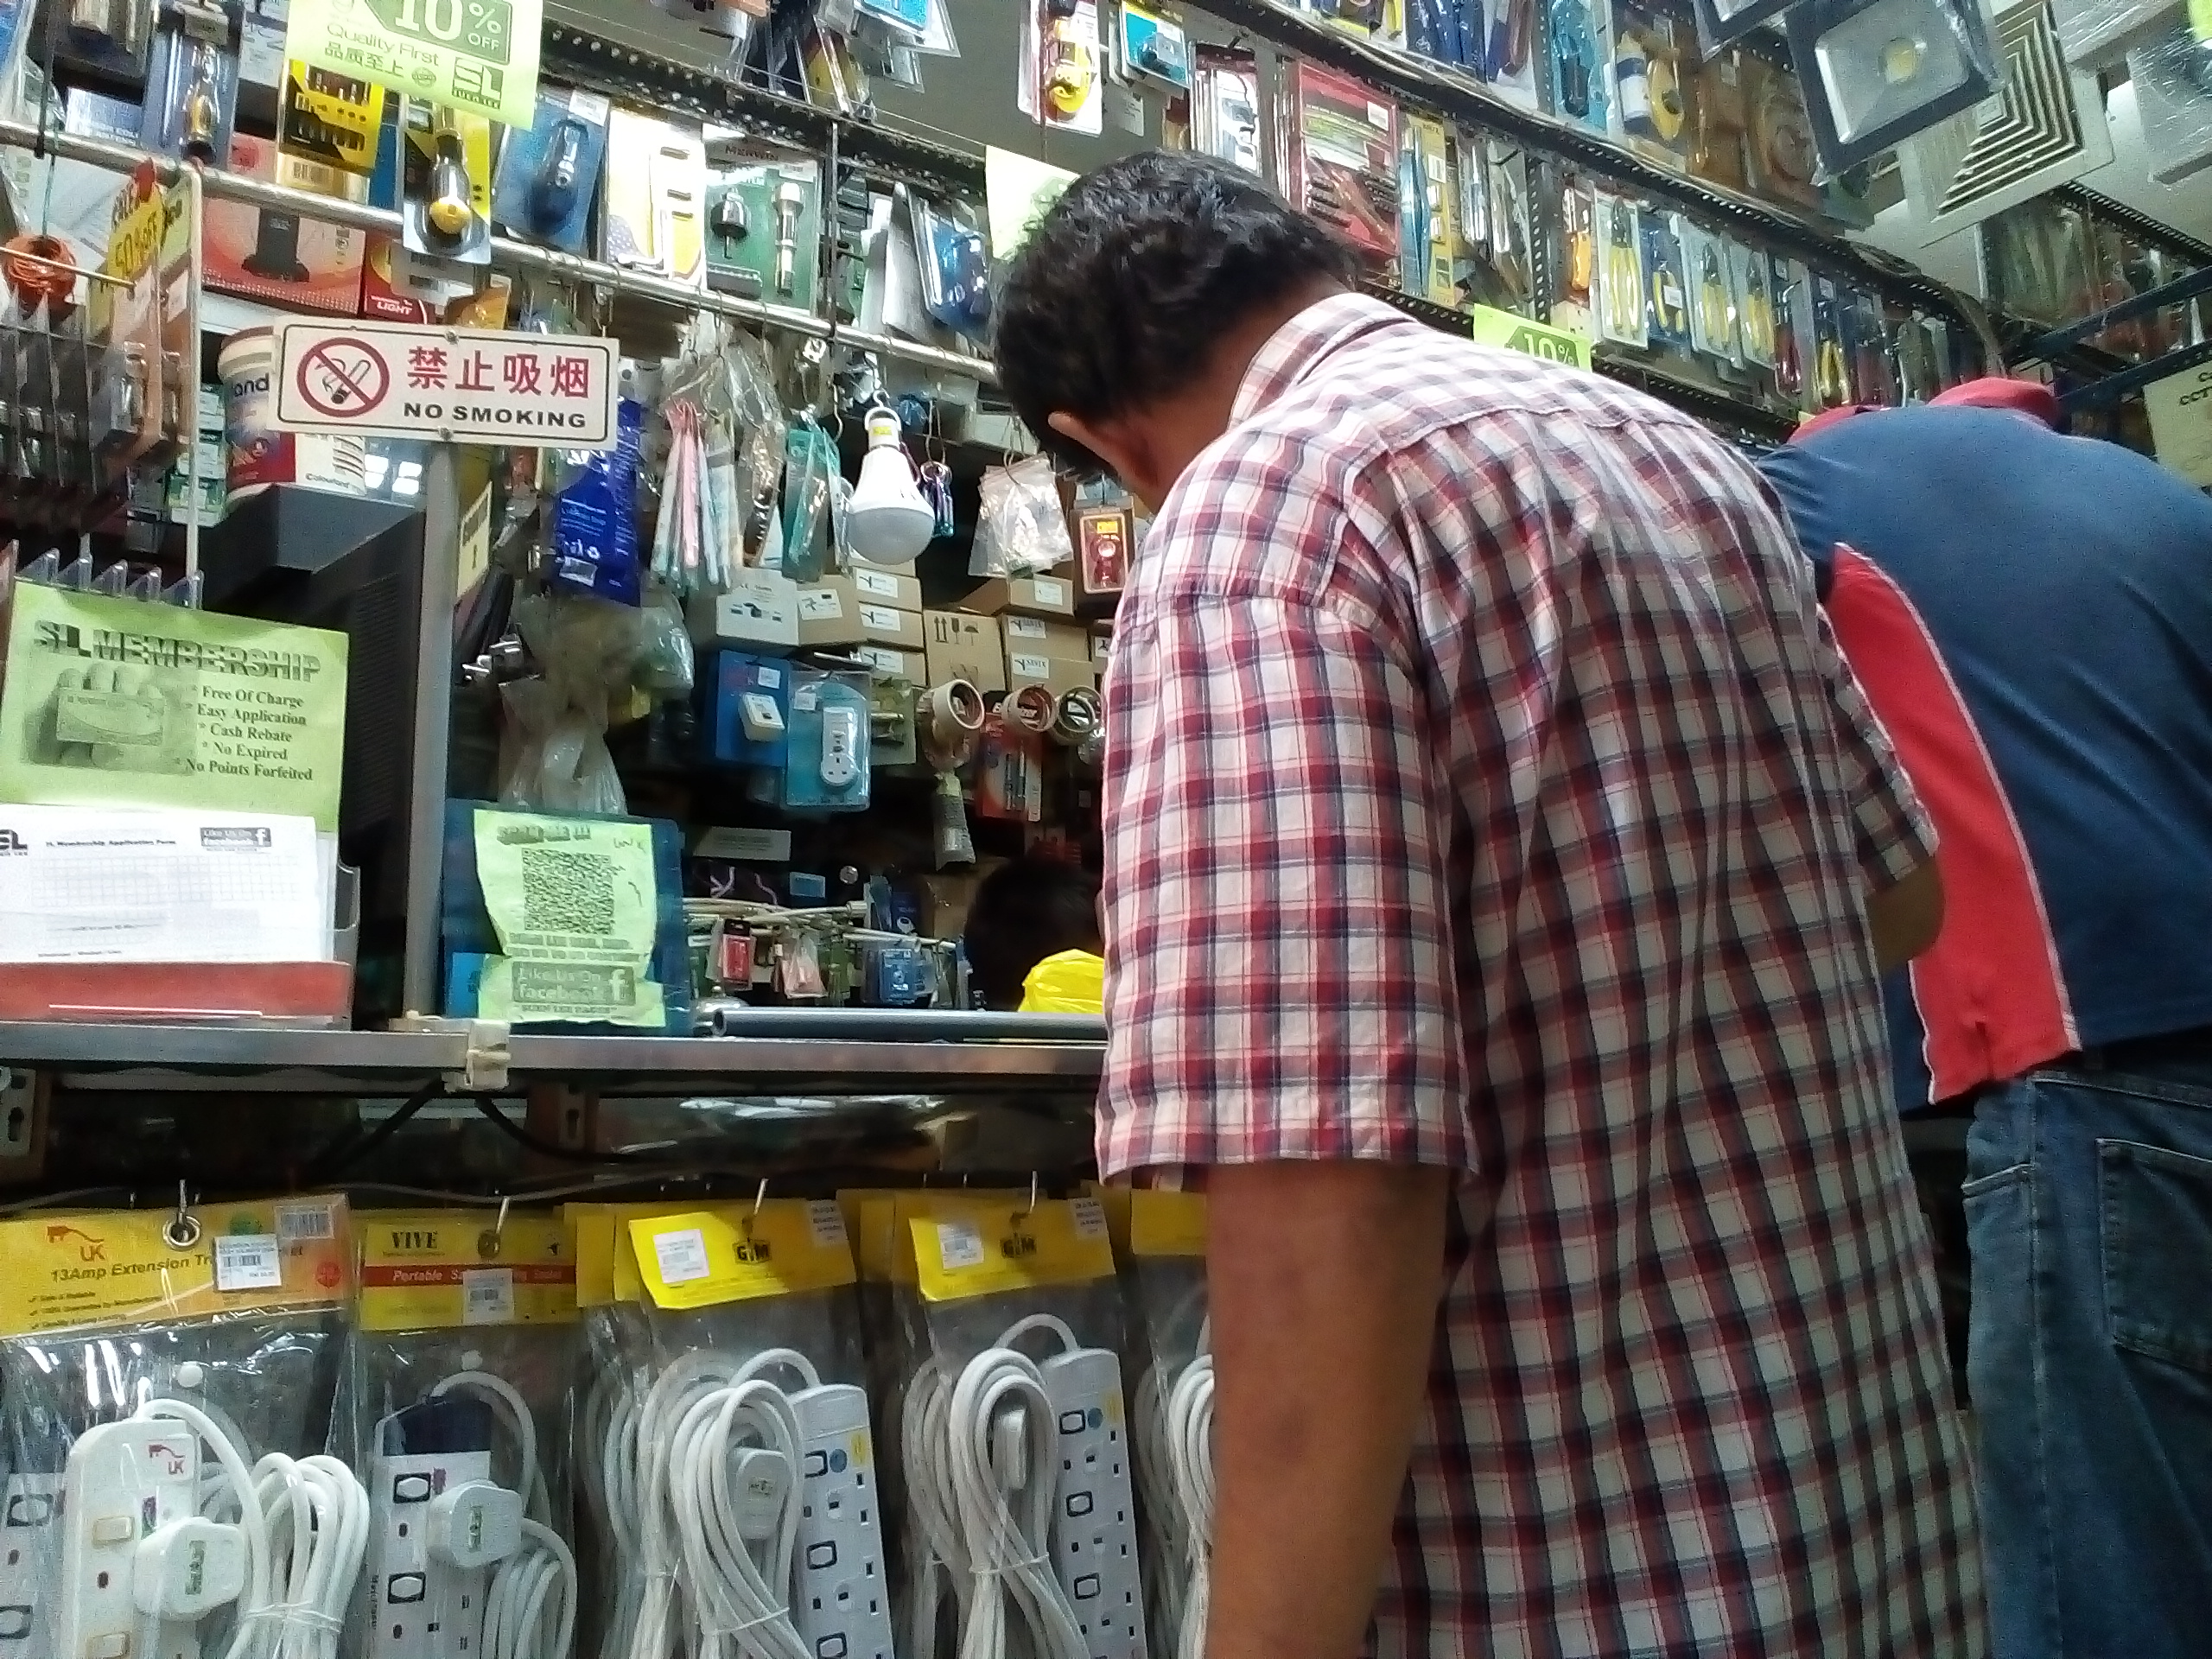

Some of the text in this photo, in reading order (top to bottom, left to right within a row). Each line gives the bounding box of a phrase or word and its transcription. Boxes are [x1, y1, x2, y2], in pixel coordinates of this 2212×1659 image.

[327, 22, 440, 67] Quality First
[467, 32, 499, 50] OFF
[407, 346, 589, 399] 禁止吸烟
[404, 402, 587, 429] NO SMOKING
[92, 628, 321, 683] MEMBERSHIP
[202, 685, 305, 709] Free Of Charge
[197, 702, 307, 727] Easy Application
[210, 723, 293, 743] Cash Rebate
[213, 741, 289, 761] No Expired
[187, 757, 314, 781] No Points Forfeited
[391, 1230, 438, 1249] VIVE
[79, 1245, 106, 1262] UK
[51, 1266, 107, 1285] 13Amp
[111, 1256, 190, 1278] Extension
[391, 1269, 443, 1282] Portable
